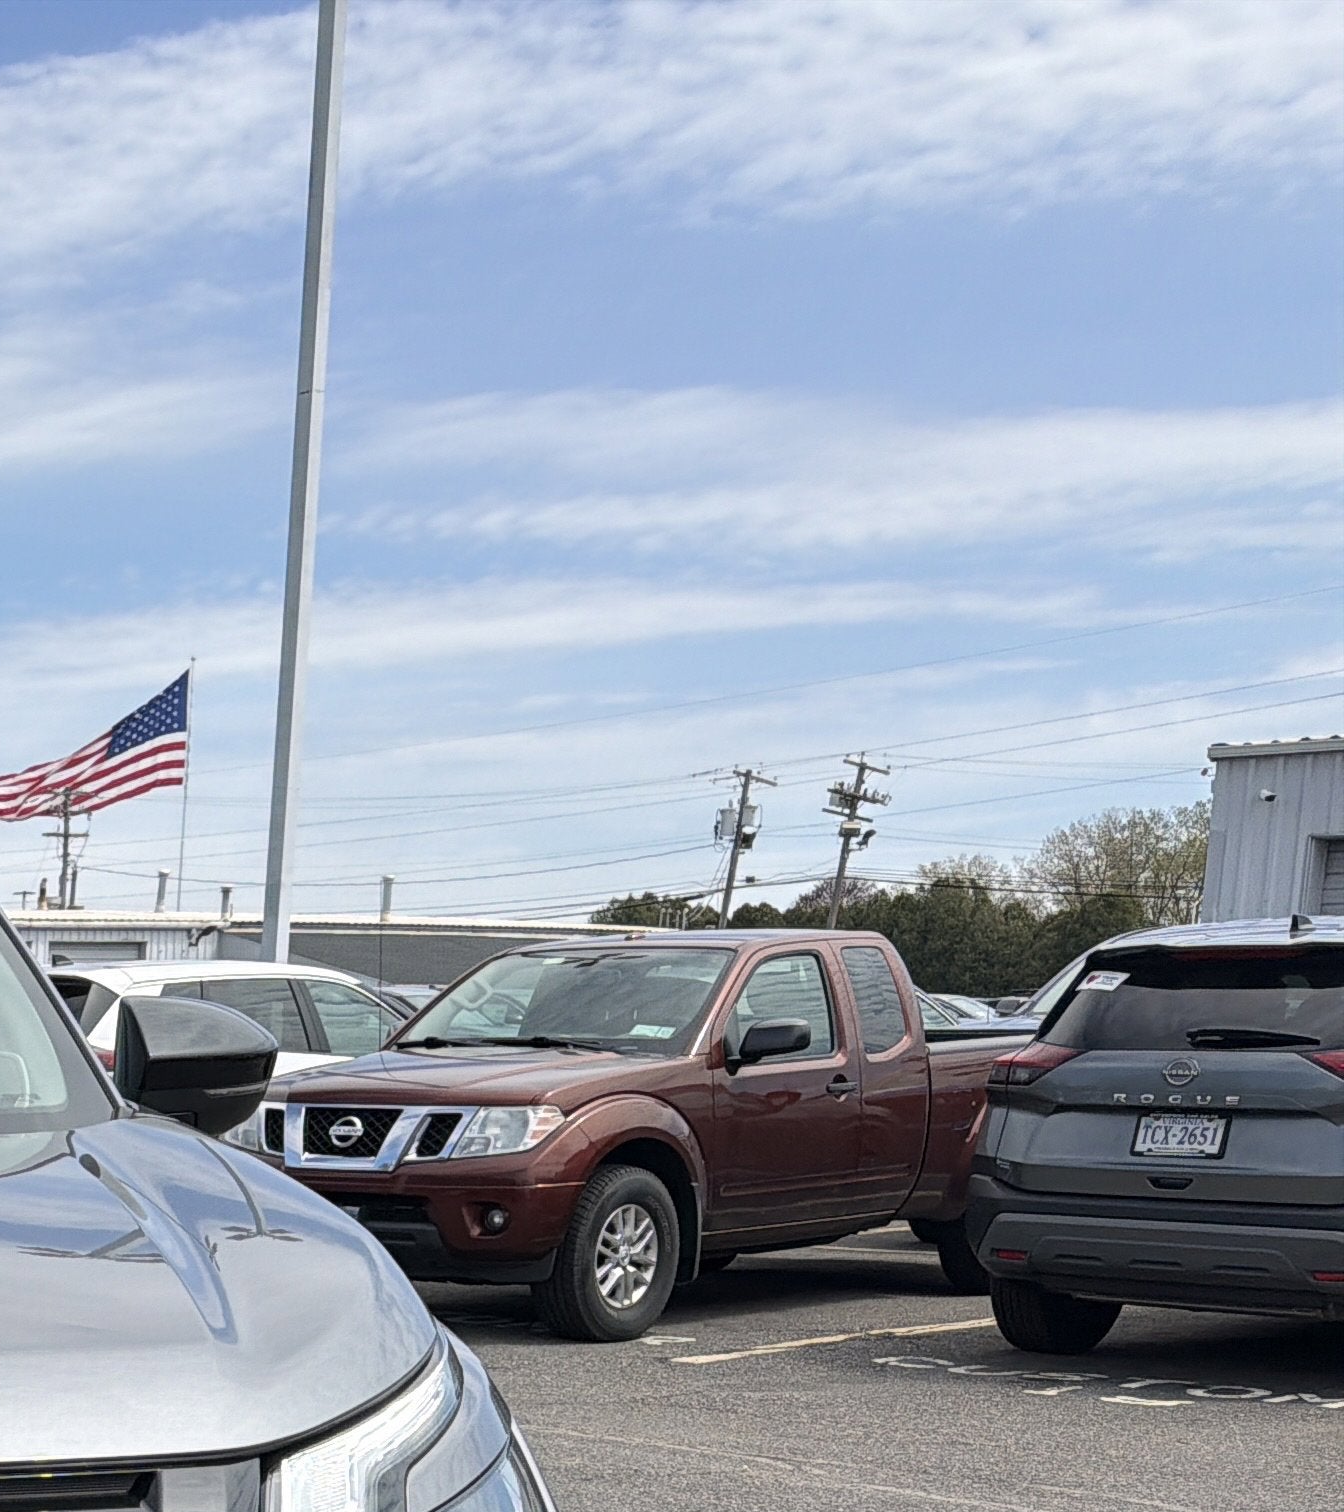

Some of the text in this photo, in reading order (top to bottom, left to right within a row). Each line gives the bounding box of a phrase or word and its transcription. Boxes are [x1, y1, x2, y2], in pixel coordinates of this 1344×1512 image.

[1113, 1093, 1240, 1105] ROGUE
[1162, 1118, 1205, 1126] VIRGINIA
[1141, 1125, 1218, 1146] TCX-2651
